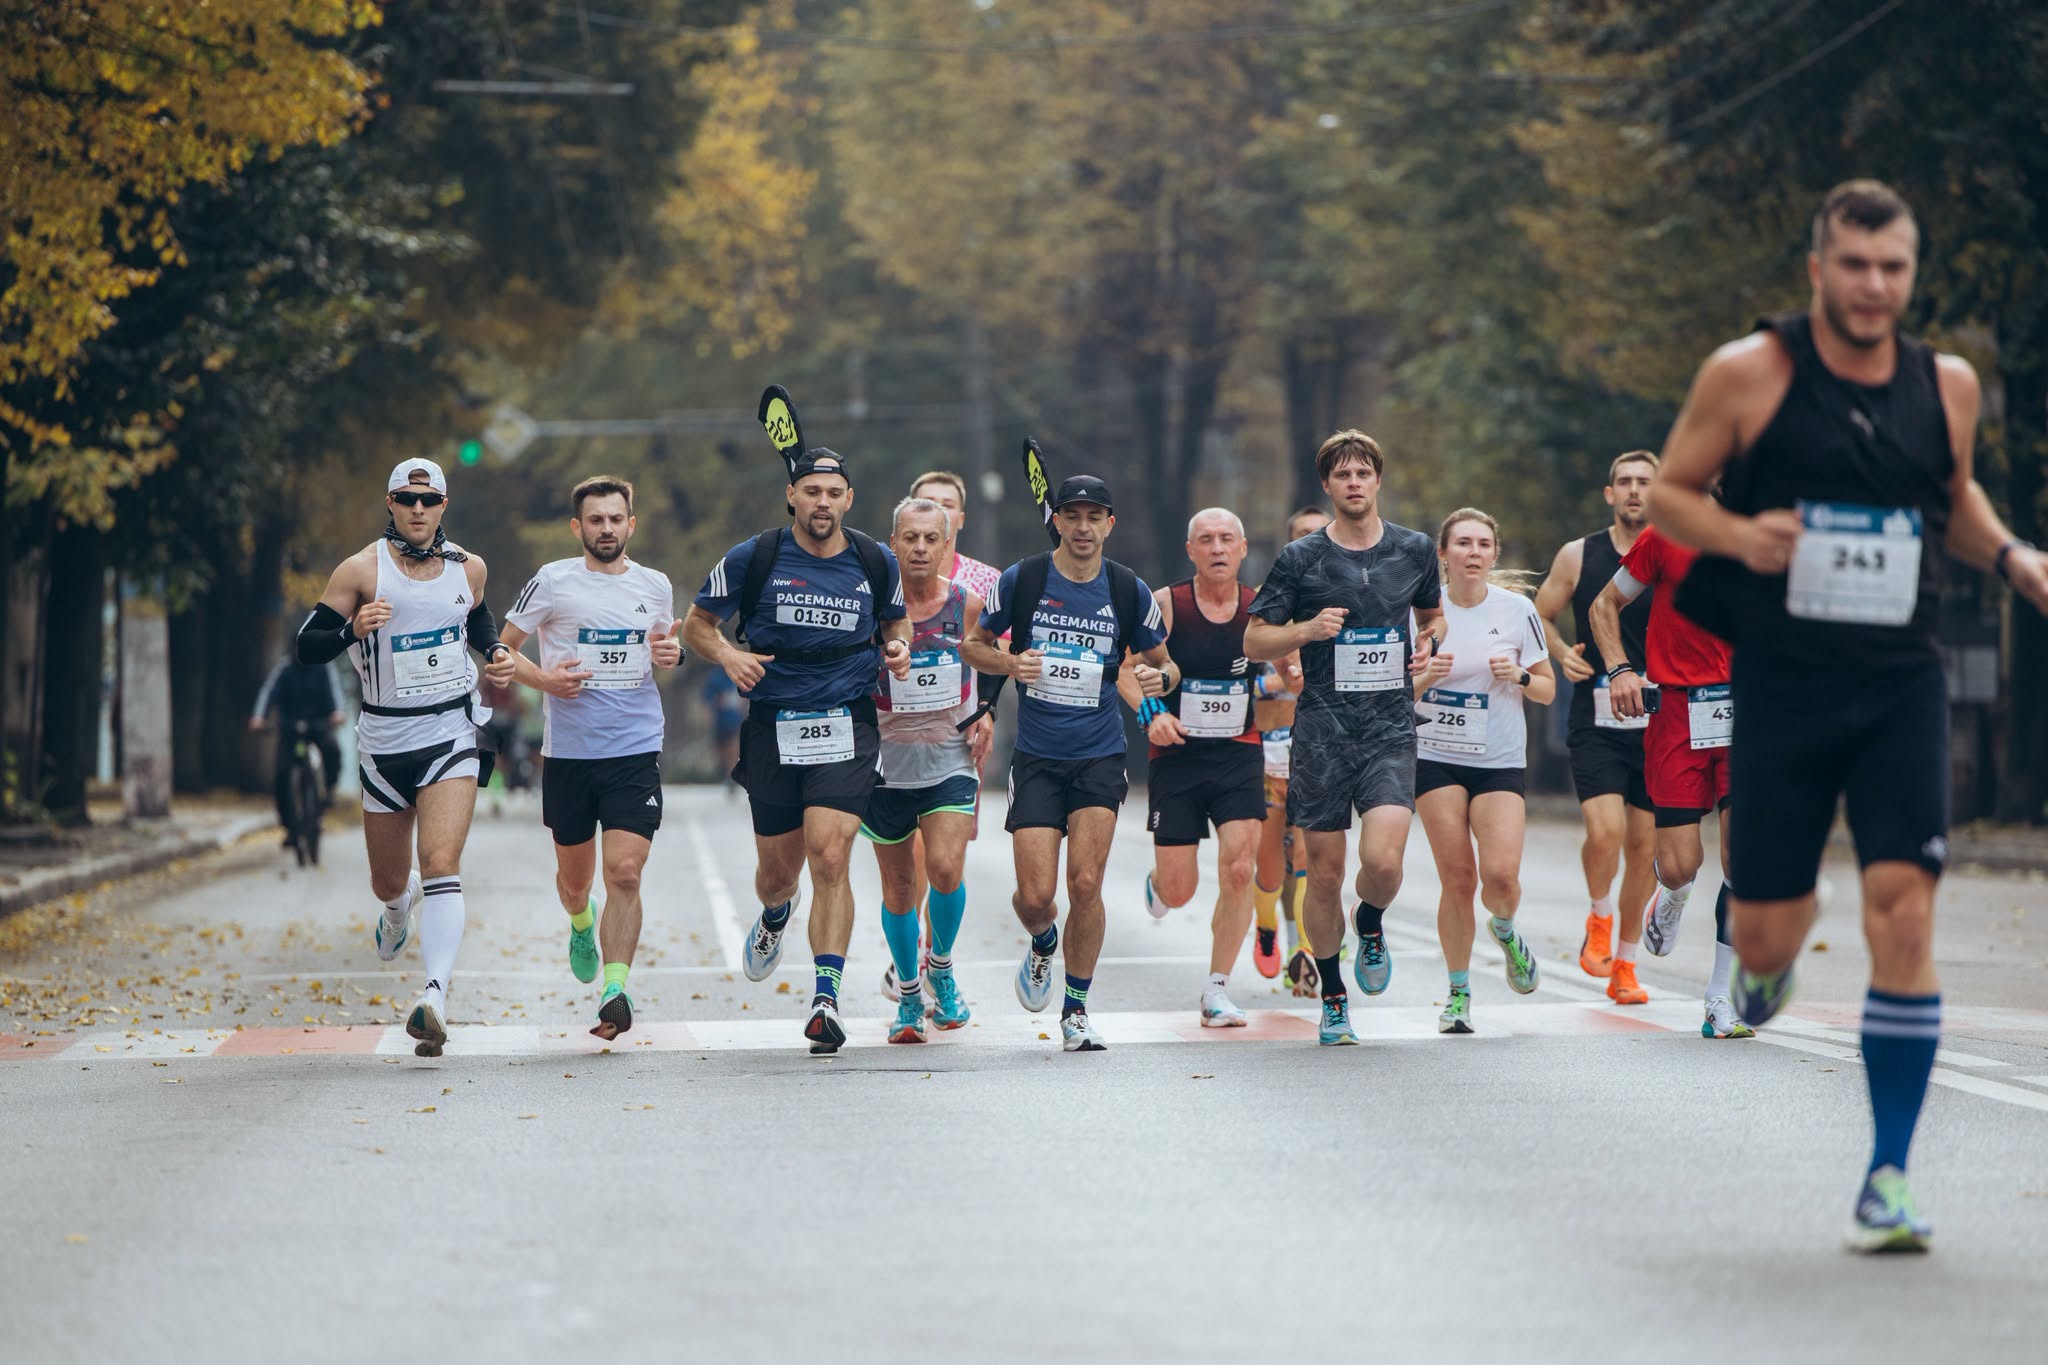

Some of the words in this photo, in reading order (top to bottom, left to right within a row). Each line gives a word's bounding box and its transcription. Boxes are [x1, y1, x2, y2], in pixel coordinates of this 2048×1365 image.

[776, 593, 861, 611] PACEMAKER
[793, 608, 842, 627] 01:30
[1032, 611, 1115, 634] PACEMAKER
[1048, 631, 1095, 650] 01:30
[427, 654, 438, 667] 6
[599, 651, 627, 664] 357
[1357, 650, 1388, 665] 207
[917, 673, 938, 687] 62
[1048, 664, 1081, 680] 285
[1201, 701, 1231, 713] 390
[1437, 711, 1466, 727] 226
[799, 724, 832, 740] 283
